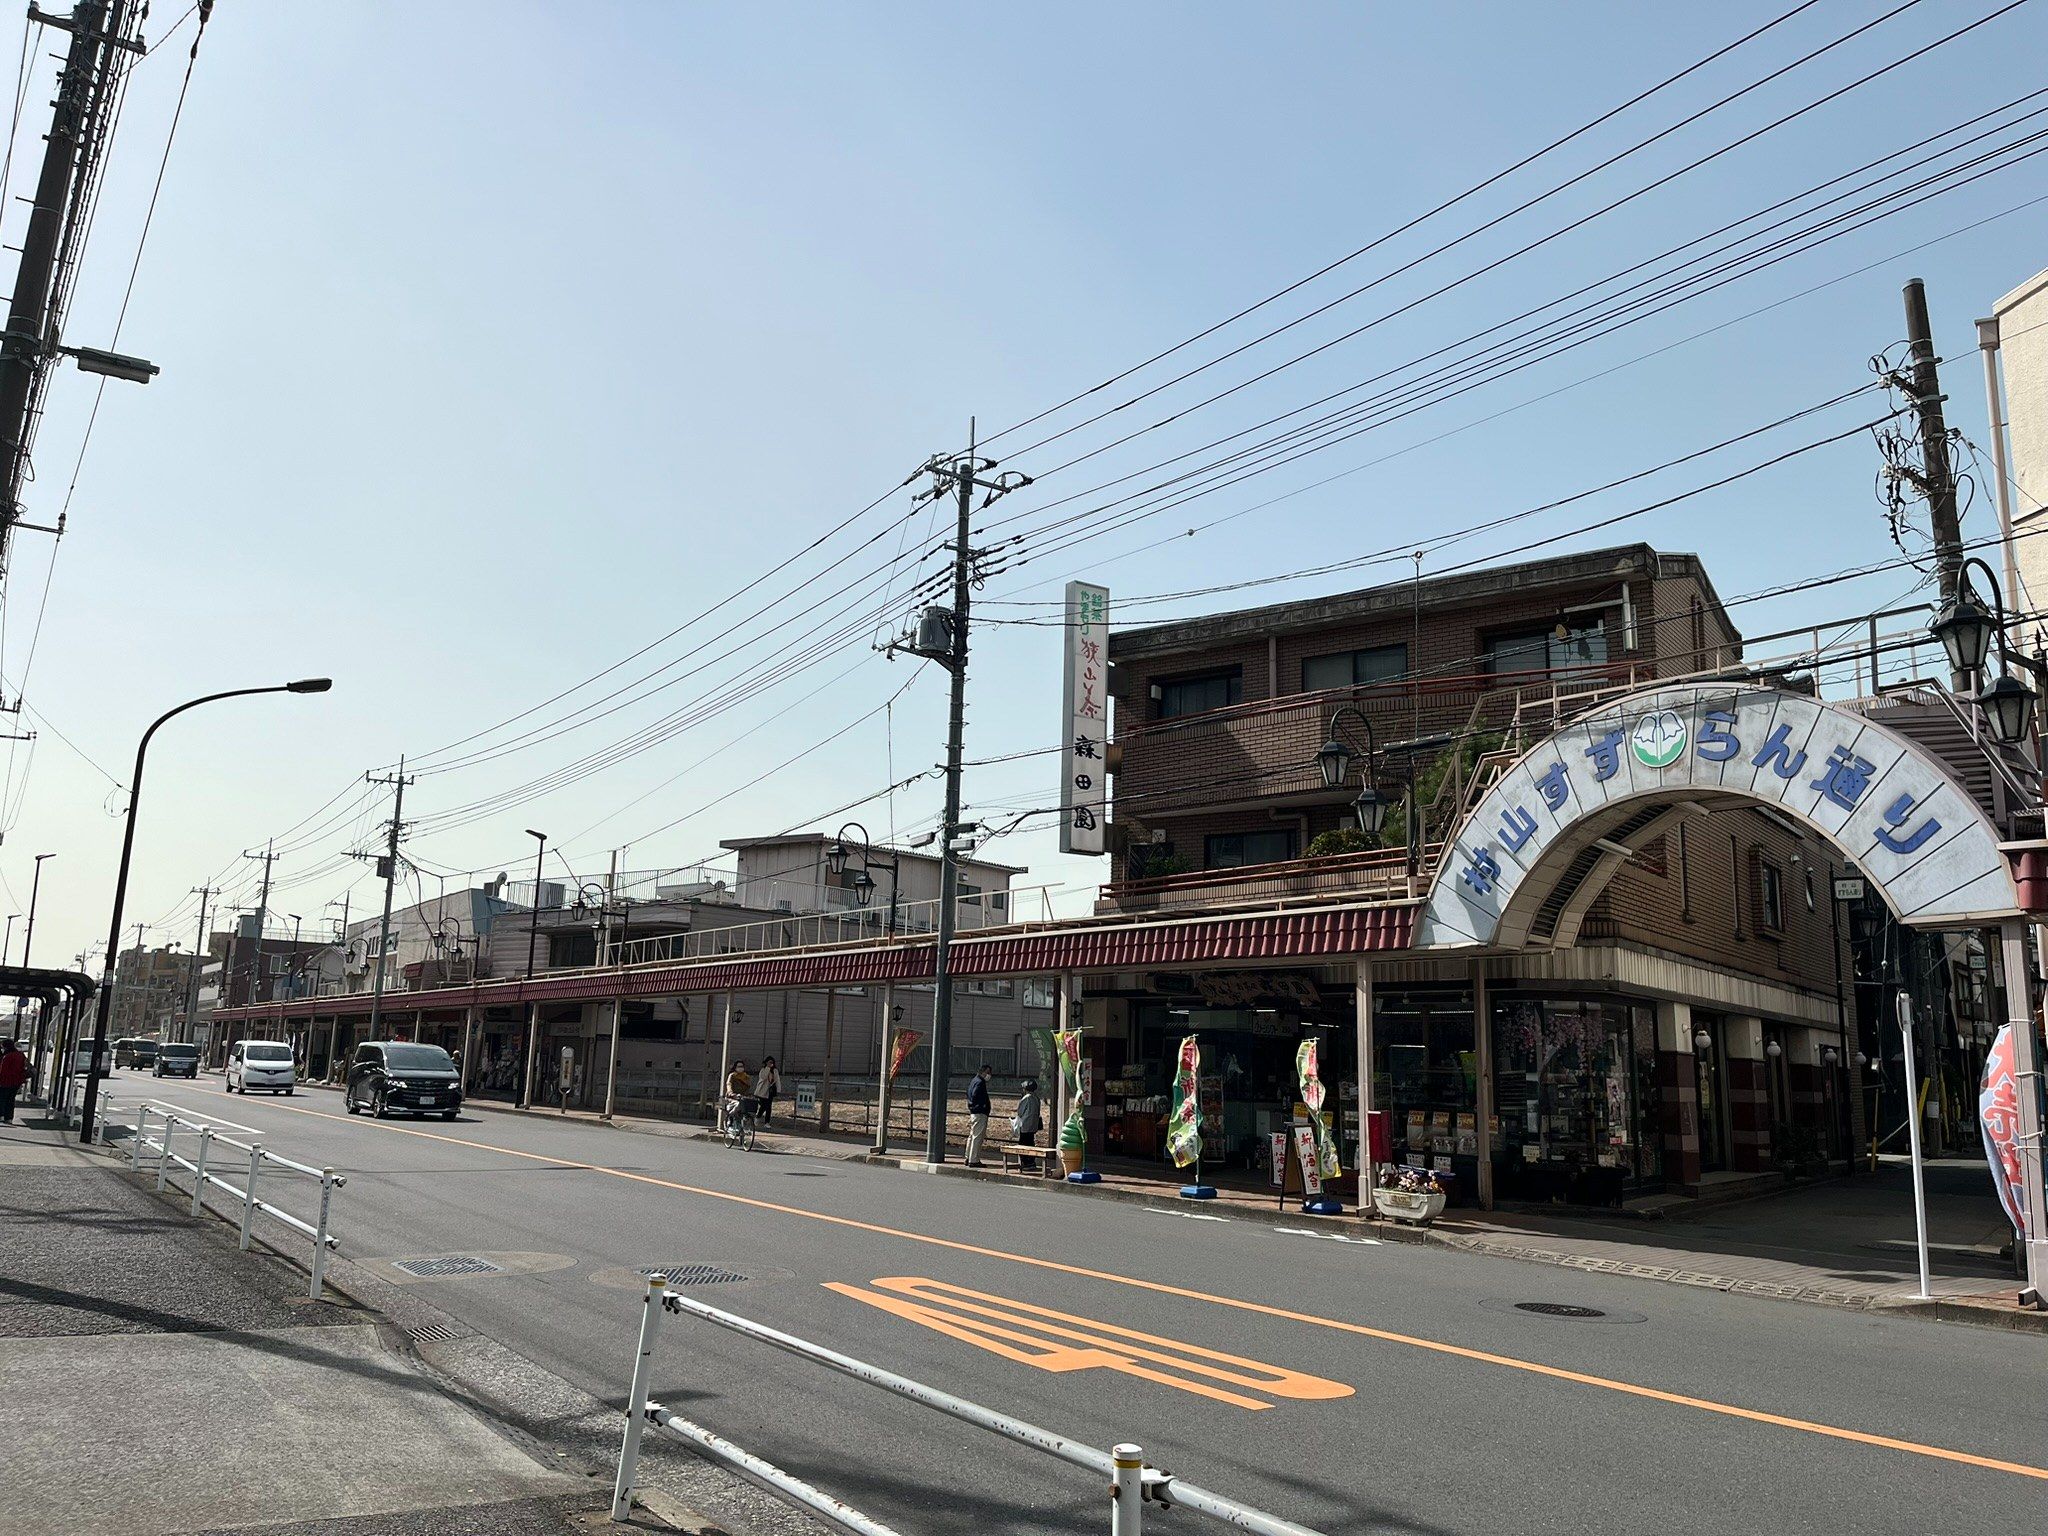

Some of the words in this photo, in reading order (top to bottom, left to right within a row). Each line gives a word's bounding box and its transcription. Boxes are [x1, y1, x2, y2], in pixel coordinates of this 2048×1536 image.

[1462, 710, 1942, 896] 村山すずらん通り
[1301, 1132, 1319, 1188] 新海苔
